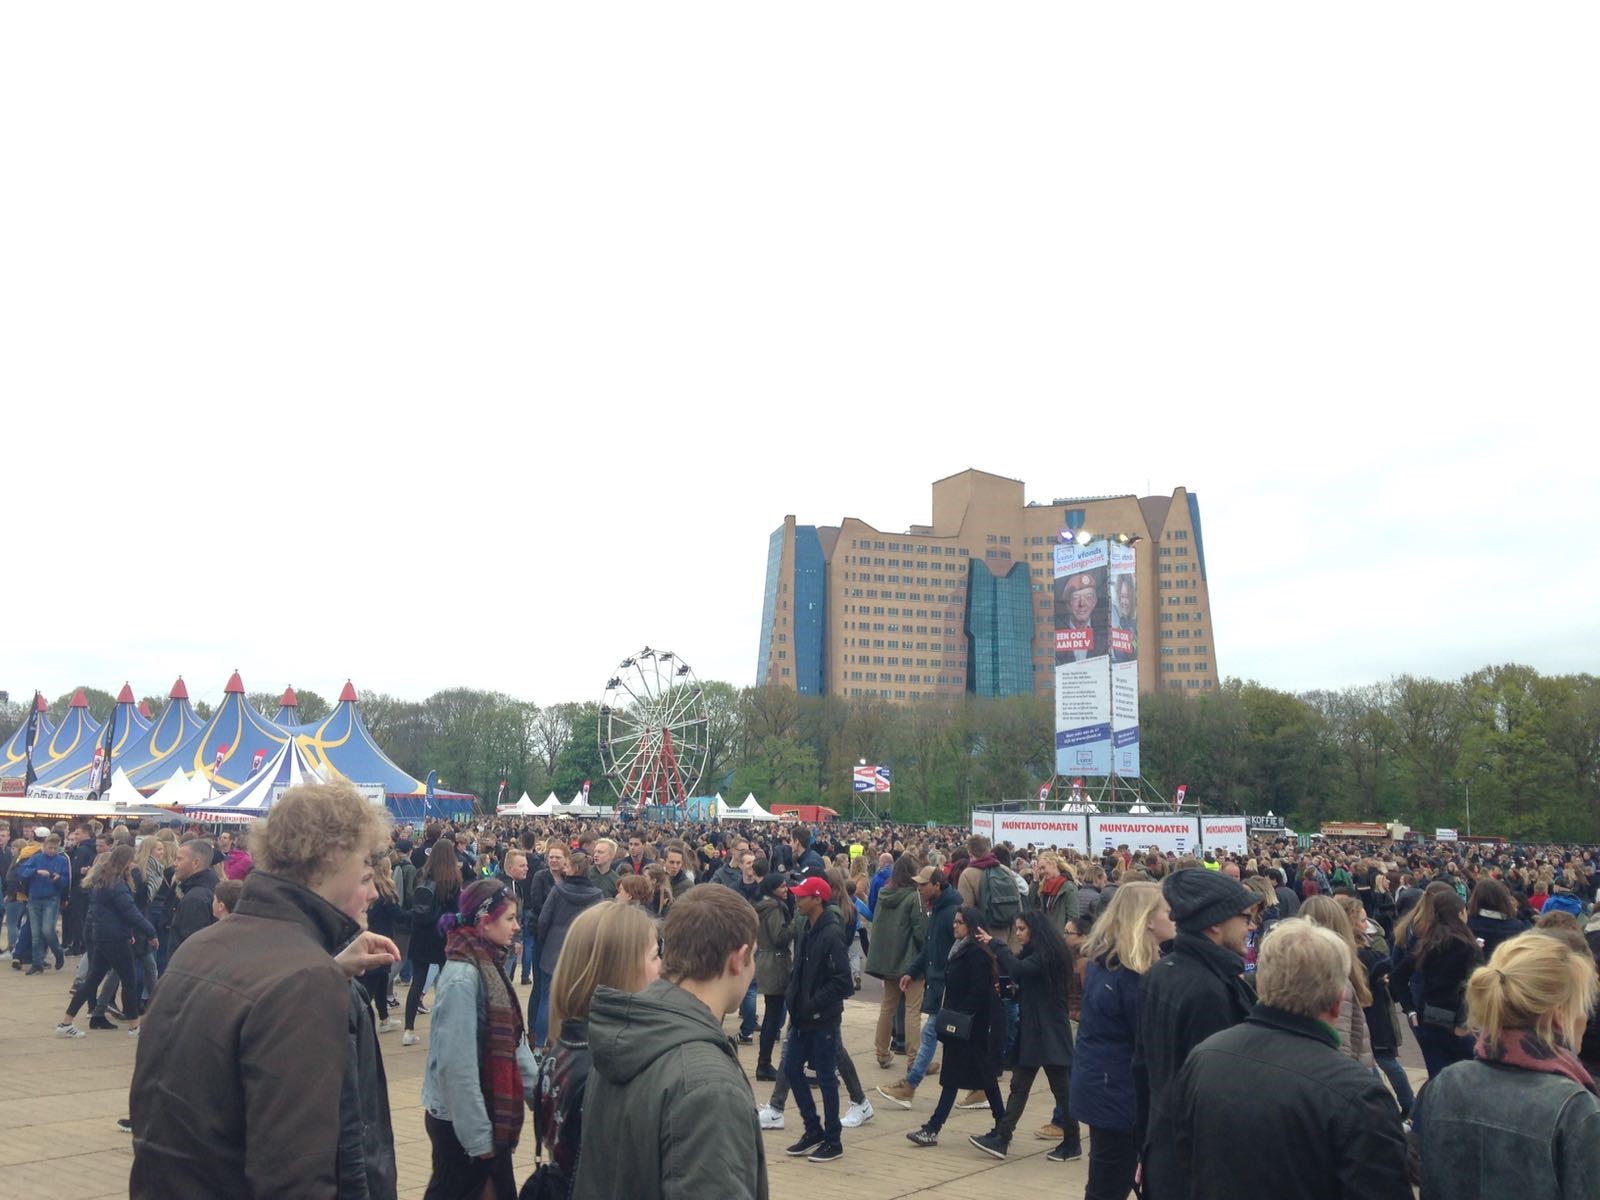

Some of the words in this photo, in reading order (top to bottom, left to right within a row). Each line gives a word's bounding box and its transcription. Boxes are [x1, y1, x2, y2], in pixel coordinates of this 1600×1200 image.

[1056, 632, 1069, 640] EEN
[1070, 631, 1087, 639] ODE
[1056, 640, 1072, 649] AAN
[1073, 640, 1083, 648] DE
[1084, 639, 1091, 647] V
[1001, 821, 1078, 831] MUNTAUTOMATEN
[1251, 816, 1278, 826] KOFFIE
[1099, 824, 1189, 834] MUNTAUTOMATEN
